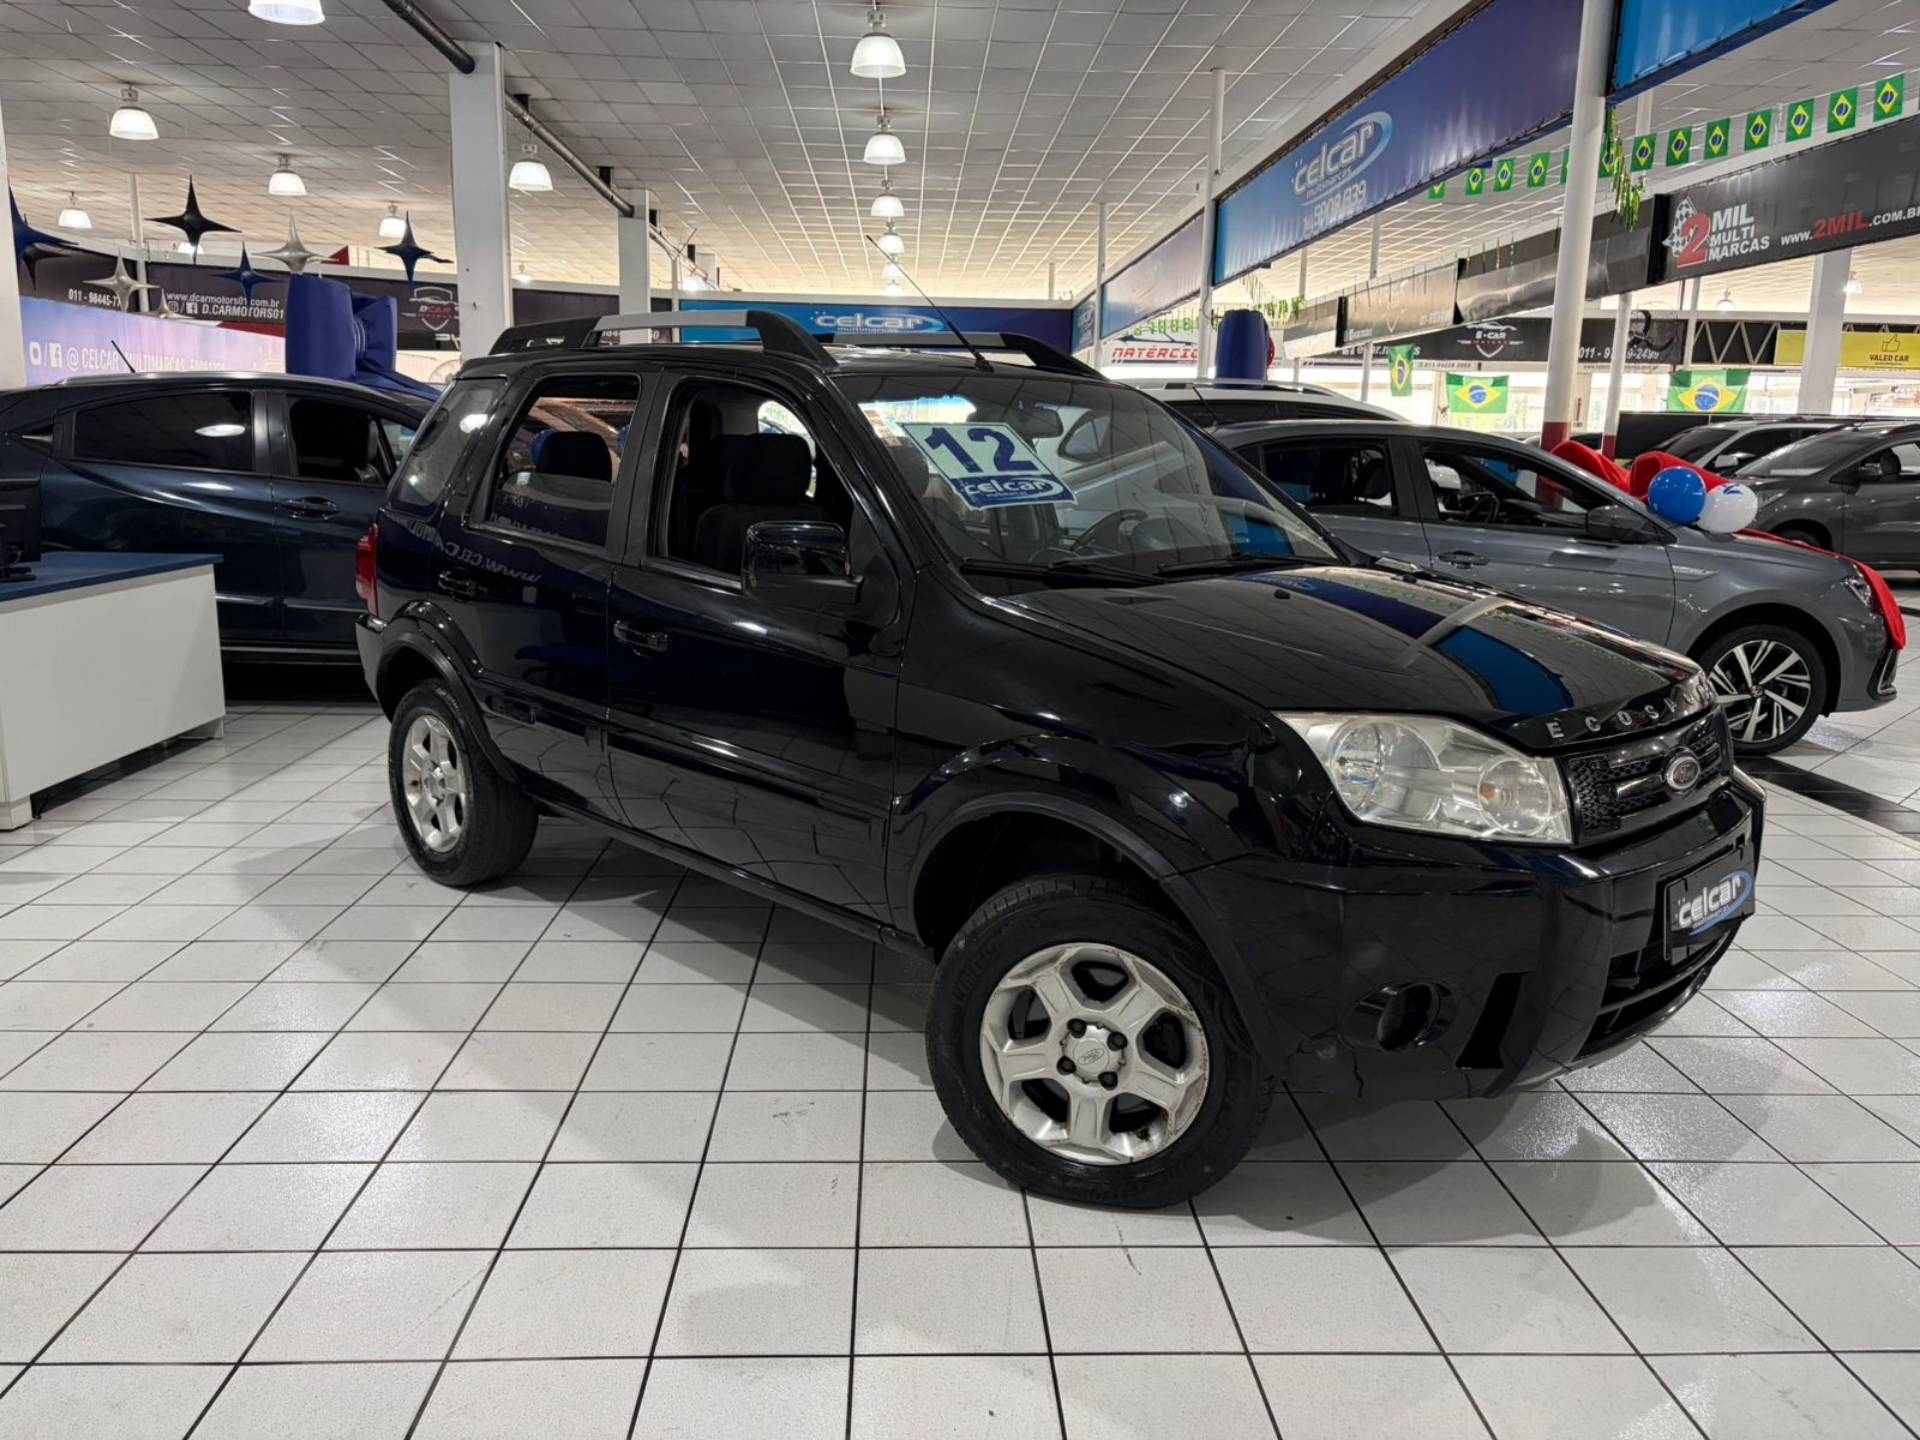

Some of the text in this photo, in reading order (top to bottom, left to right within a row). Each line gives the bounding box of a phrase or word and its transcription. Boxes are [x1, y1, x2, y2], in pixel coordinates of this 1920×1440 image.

[1294, 119, 1375, 195] celcar
[1676, 203, 1755, 268] 2 MIL
[1708, 235, 1771, 262] MARCAS
[1709, 224, 1756, 247] MULTI
[815, 313, 922, 330] celcar
[82, 349, 120, 371] CELCAR
[924, 427, 1039, 473] 12
[965, 480, 1046, 496] celcar
[1679, 874, 1742, 929] celcar
